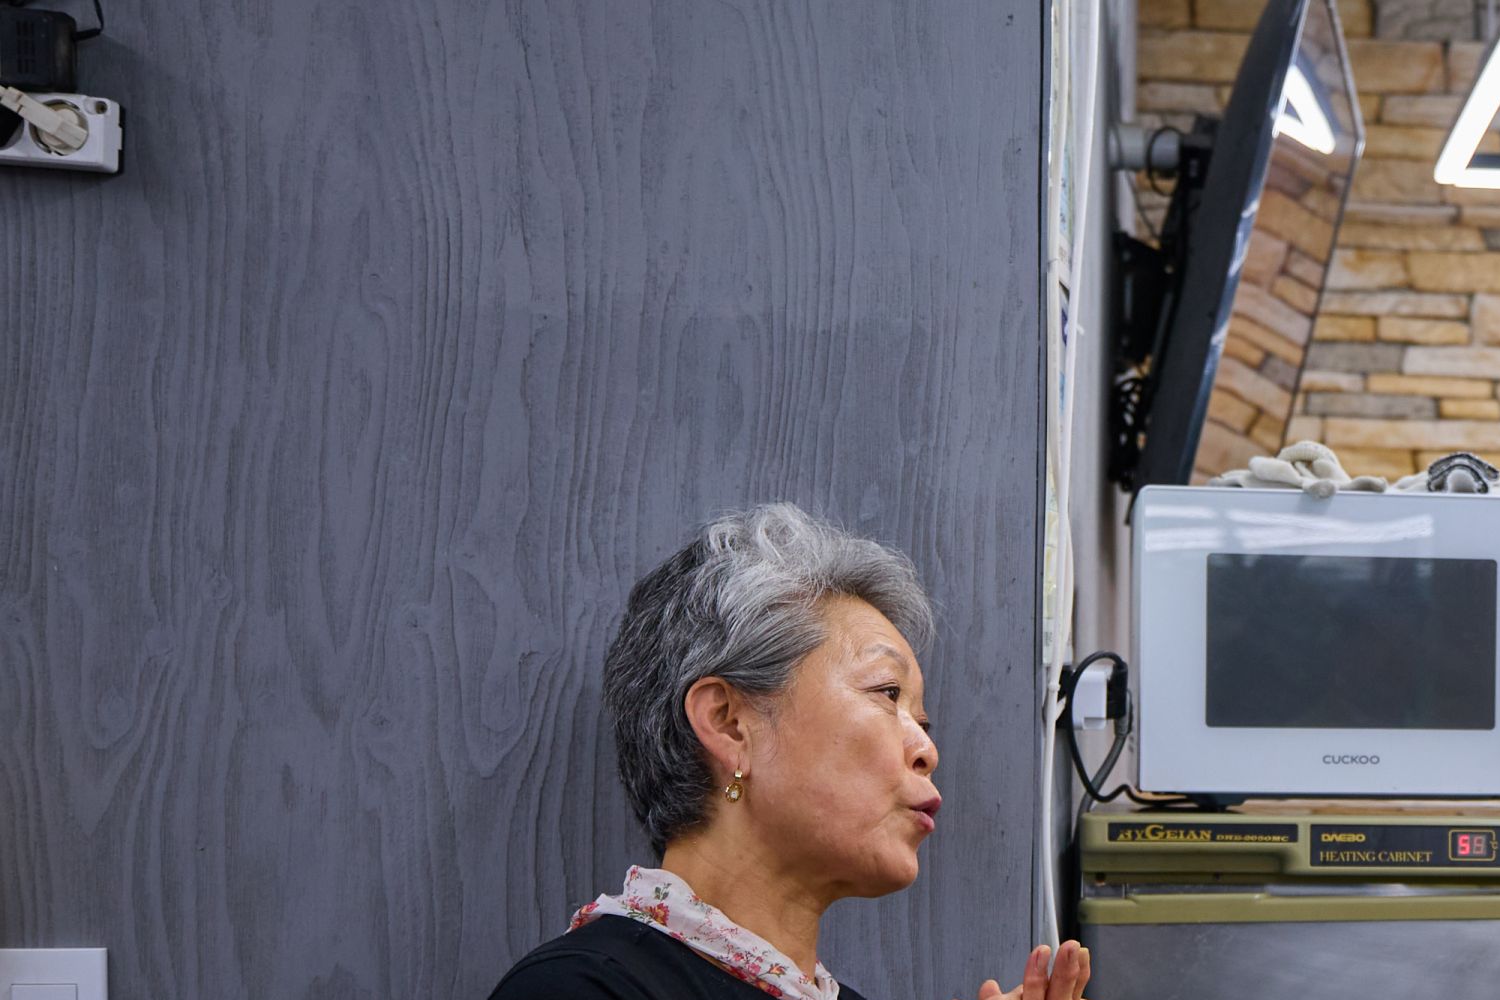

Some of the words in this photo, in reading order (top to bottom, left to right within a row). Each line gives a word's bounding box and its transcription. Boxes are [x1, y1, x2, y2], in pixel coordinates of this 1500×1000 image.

[1322, 754, 1380, 765] CUCKOO
[1320, 851, 1376, 862] HEATING
[1378, 851, 1433, 862] CABINET
